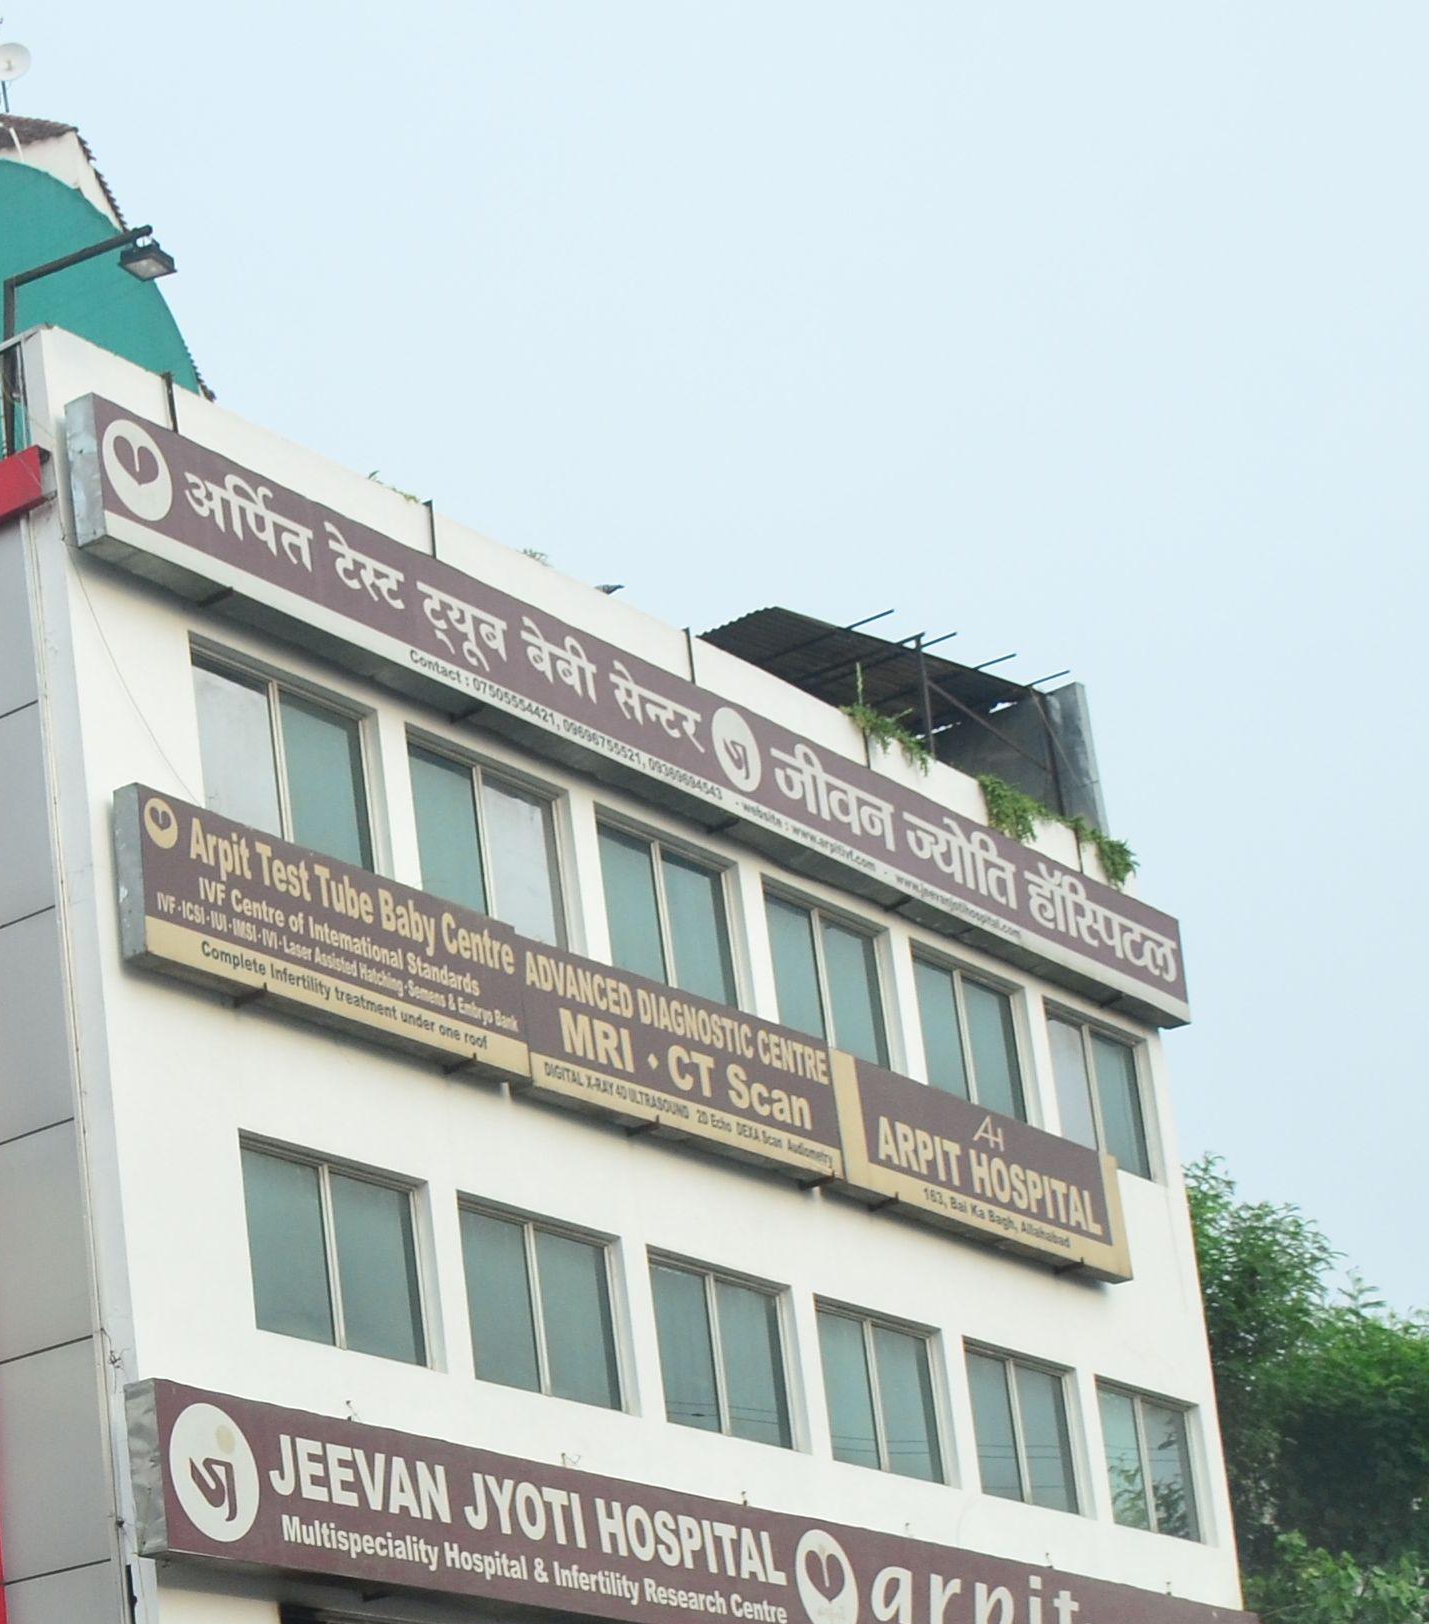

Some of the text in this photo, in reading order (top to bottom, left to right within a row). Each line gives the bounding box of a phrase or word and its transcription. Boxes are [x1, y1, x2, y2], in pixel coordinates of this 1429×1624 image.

[184, 472, 705, 753] अर्पित टेस्ट ट्यूब बेबी सेन्टर
[410, 650, 461, 684] Contact
[190, 817, 515, 975] Arpit Test Tube Baby Centre
[770, 743, 1177, 983] जीवन ज्योति हॉस्पिटल
[198, 876, 480, 996] IVF Centre of International Standards
[201, 940, 488, 1050] Complete Infertility treatment under one roof
[525, 950, 830, 1086] ADVANCED DIAGNOSTIC CENTRE
[558, 1007, 813, 1131] MRI CT Scan
[877, 1115, 1104, 1236] ARPIT HOSPITAL
[269, 1433, 788, 1586] JEEVAN JYOTI HOSPITAL
[281, 1514, 789, 1624] Multispeciality Hospital & Infertility Research Centre
